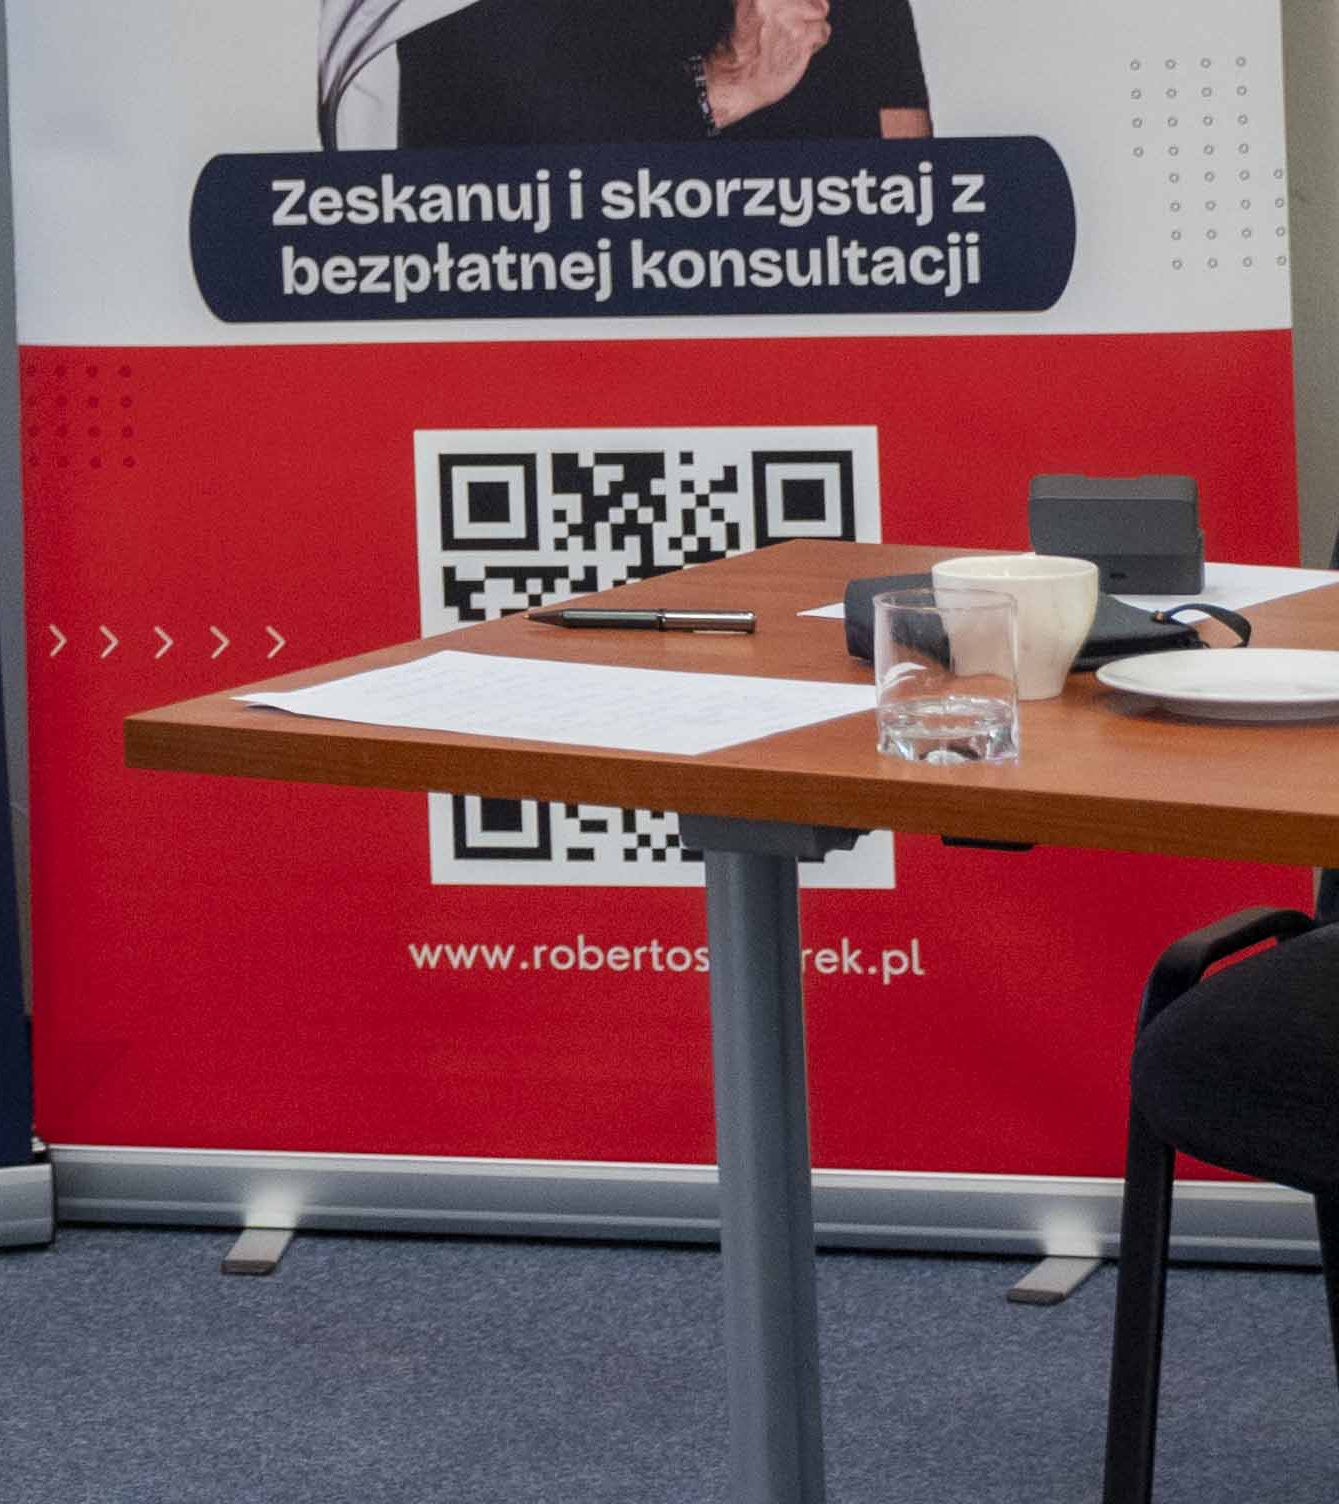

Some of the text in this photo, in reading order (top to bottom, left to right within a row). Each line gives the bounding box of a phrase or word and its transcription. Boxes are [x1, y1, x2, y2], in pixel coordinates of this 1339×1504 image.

[271, 160, 986, 234] Zeskanuj i skorzystaj z
[281, 231, 981, 304] bezpłatnej konsultacji
[408, 935, 925, 985] www.robertosrek.pl
